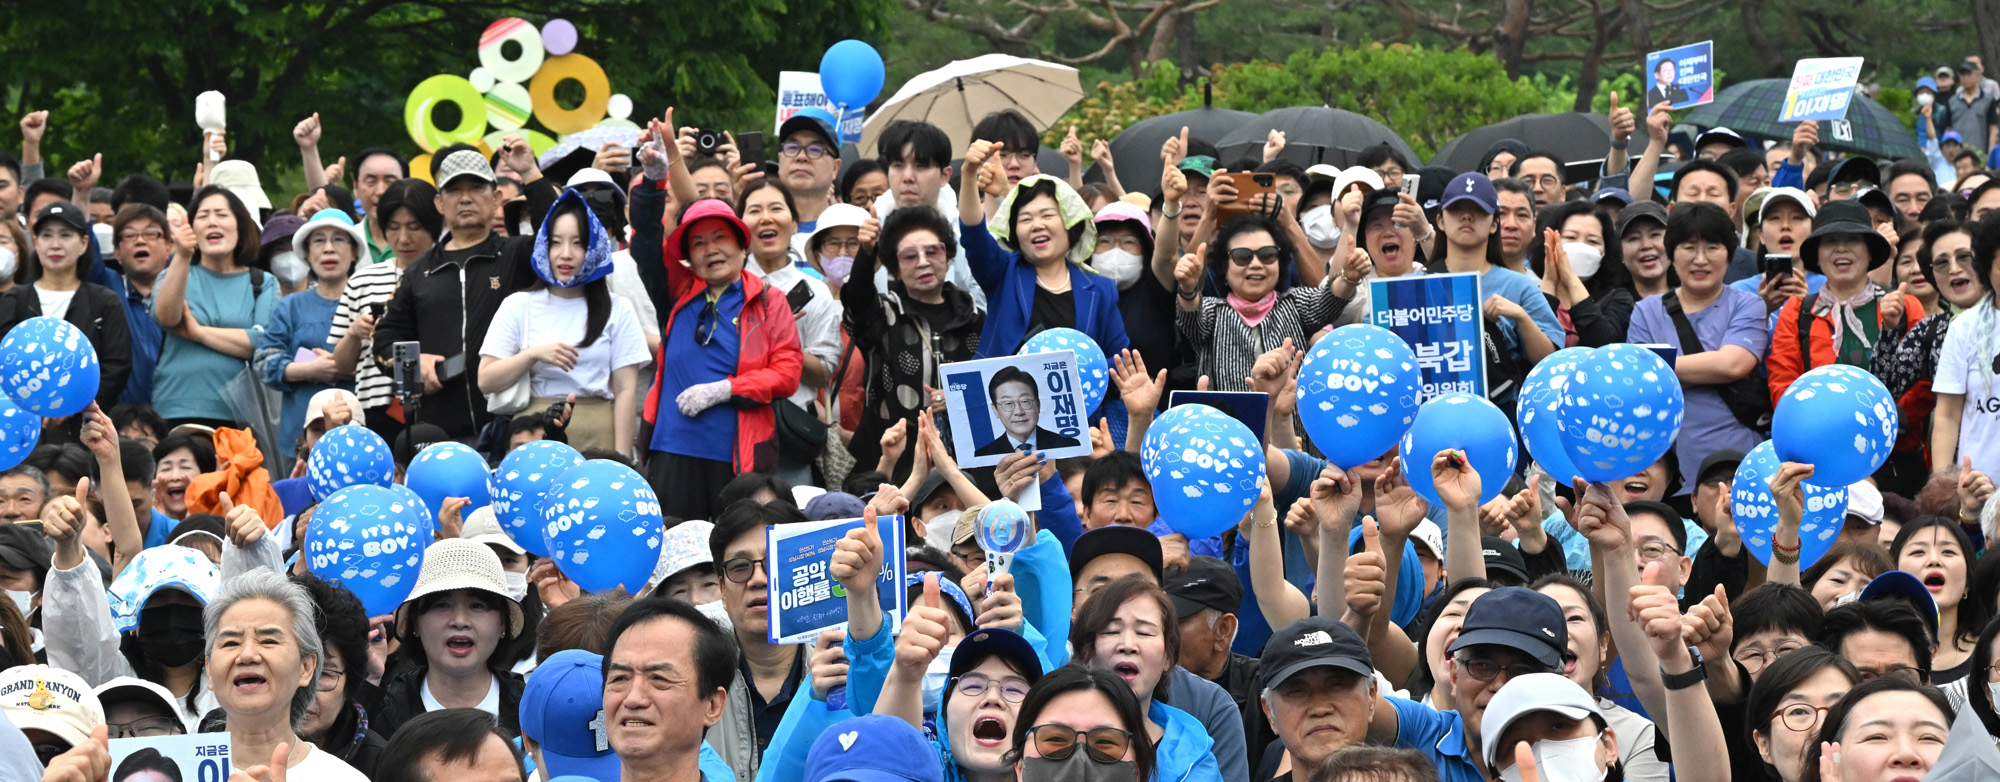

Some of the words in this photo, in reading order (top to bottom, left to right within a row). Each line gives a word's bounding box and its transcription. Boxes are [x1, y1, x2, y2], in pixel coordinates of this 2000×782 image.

[1793, 91, 1849, 117] 이재명
[1377, 304, 1474, 327] 더불어민주당
[1043, 361, 1067, 371] 지금은
[1332, 358, 1362, 373] IT'S
[17, 367, 50, 399] BOY
[1327, 373, 1379, 394] BOY
[1047, 370, 1082, 439] 이재명
[1189, 436, 1216, 453] IT'S
[1585, 427, 1636, 450] BOY
[1182, 448, 1228, 473] BOY
[1737, 489, 1755, 502] IT'S
[1807, 489, 1844, 513] BOY
[546, 503, 565, 520] IT'S
[1735, 502, 1771, 519] BOY
[361, 524, 391, 539] IT'S
[394, 521, 405, 533] A
[547, 510, 585, 538] BOY
[363, 535, 408, 557] BOY
[792, 560, 827, 588] 공약
[781, 580, 831, 611] 이행률
[1, 680, 34, 696] GRAND
[36, 681, 82, 703] ANYON
[195, 744, 229, 757] 지금은
